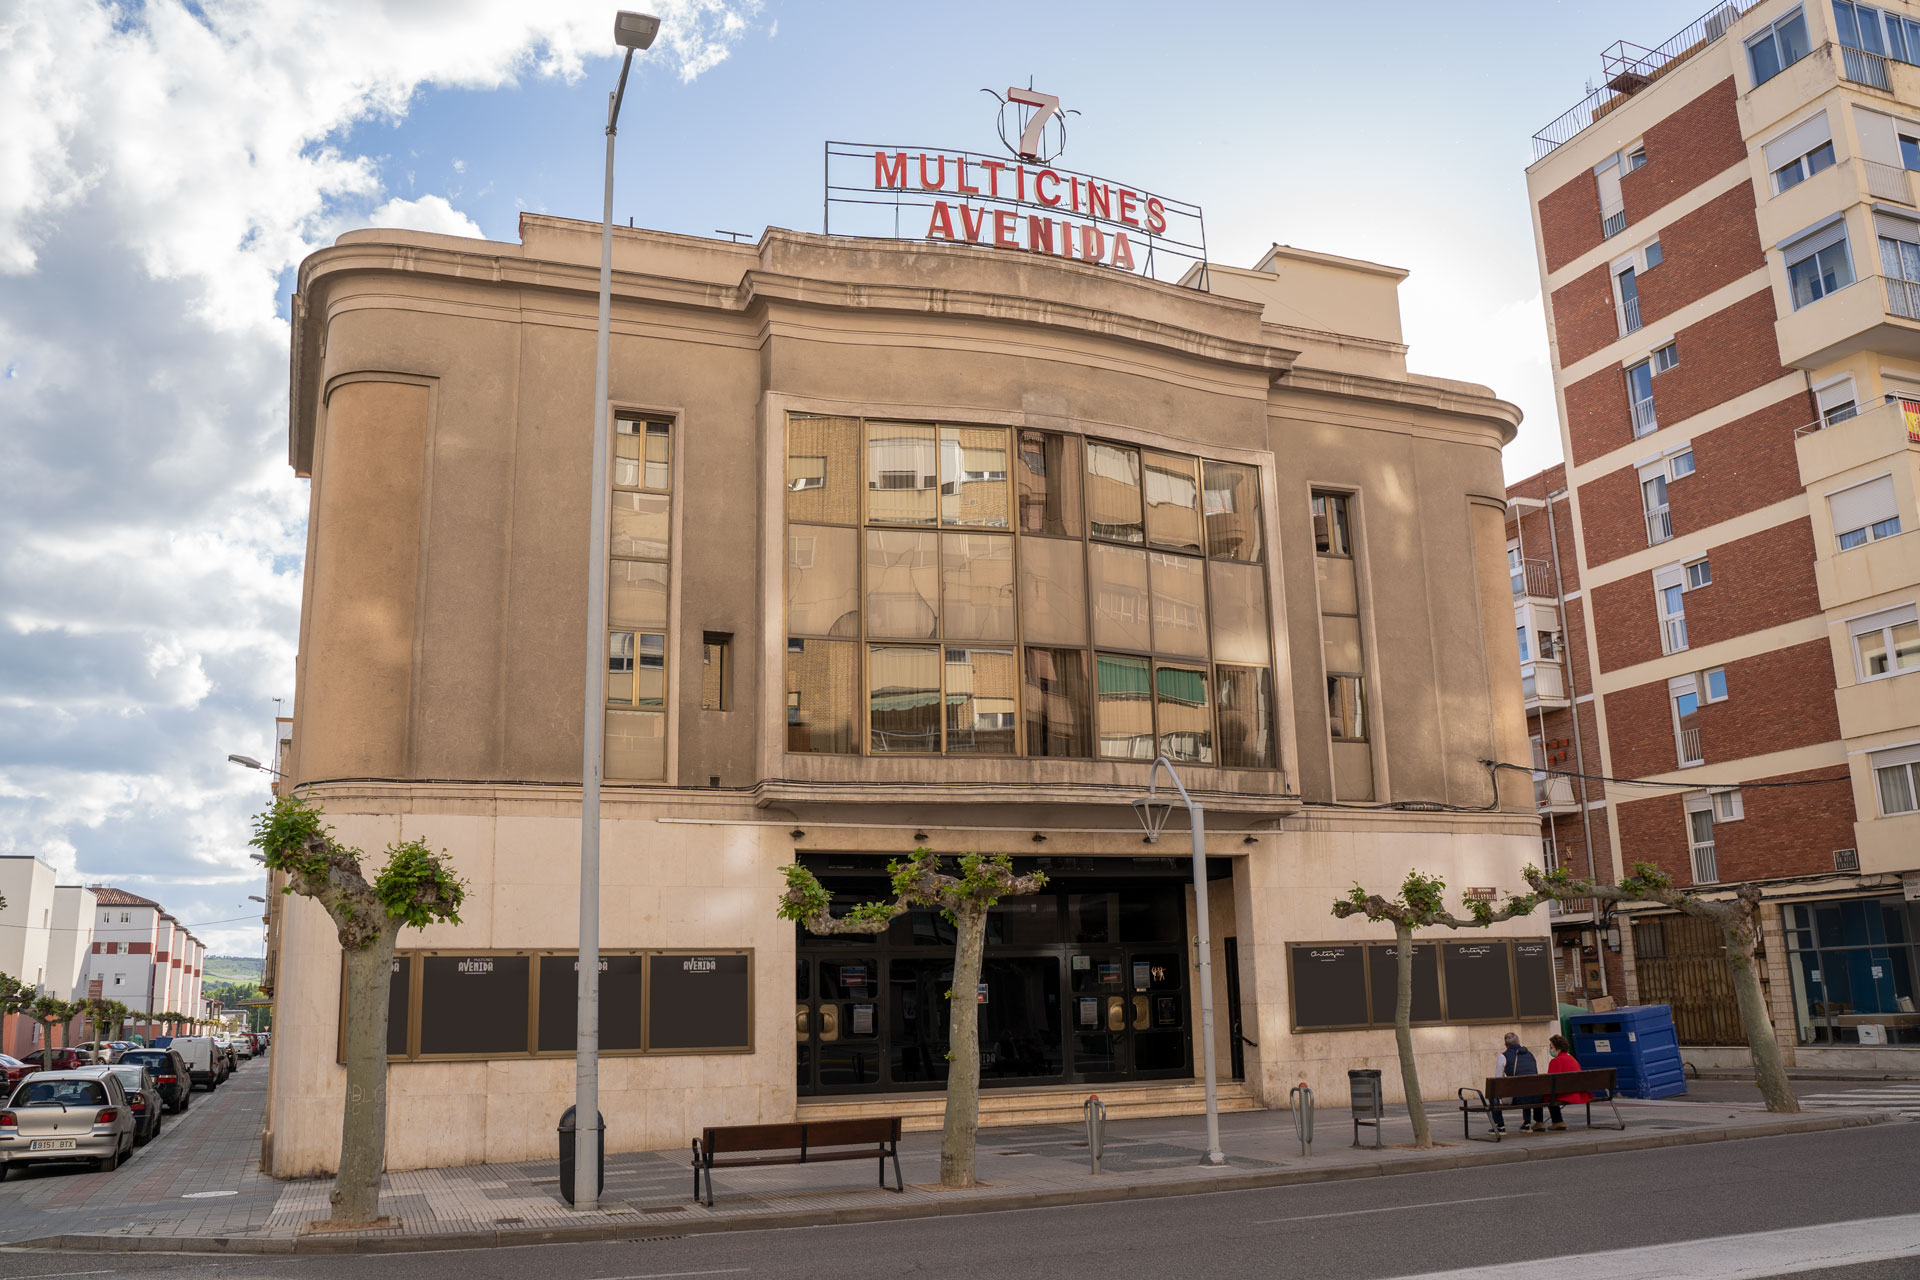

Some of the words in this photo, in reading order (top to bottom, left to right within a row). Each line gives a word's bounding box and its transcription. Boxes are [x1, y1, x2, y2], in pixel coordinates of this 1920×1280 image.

[1006, 86, 1060, 160] 7
[874, 151, 1168, 236] MULTICINES
[926, 200, 1136, 271] AVENIDA
[458, 958, 494, 972] AVENIDA
[683, 957, 716, 971] AVENIDA
[37, 1141, 55, 1149] 9151
[60, 1140, 73, 1148] BTX
